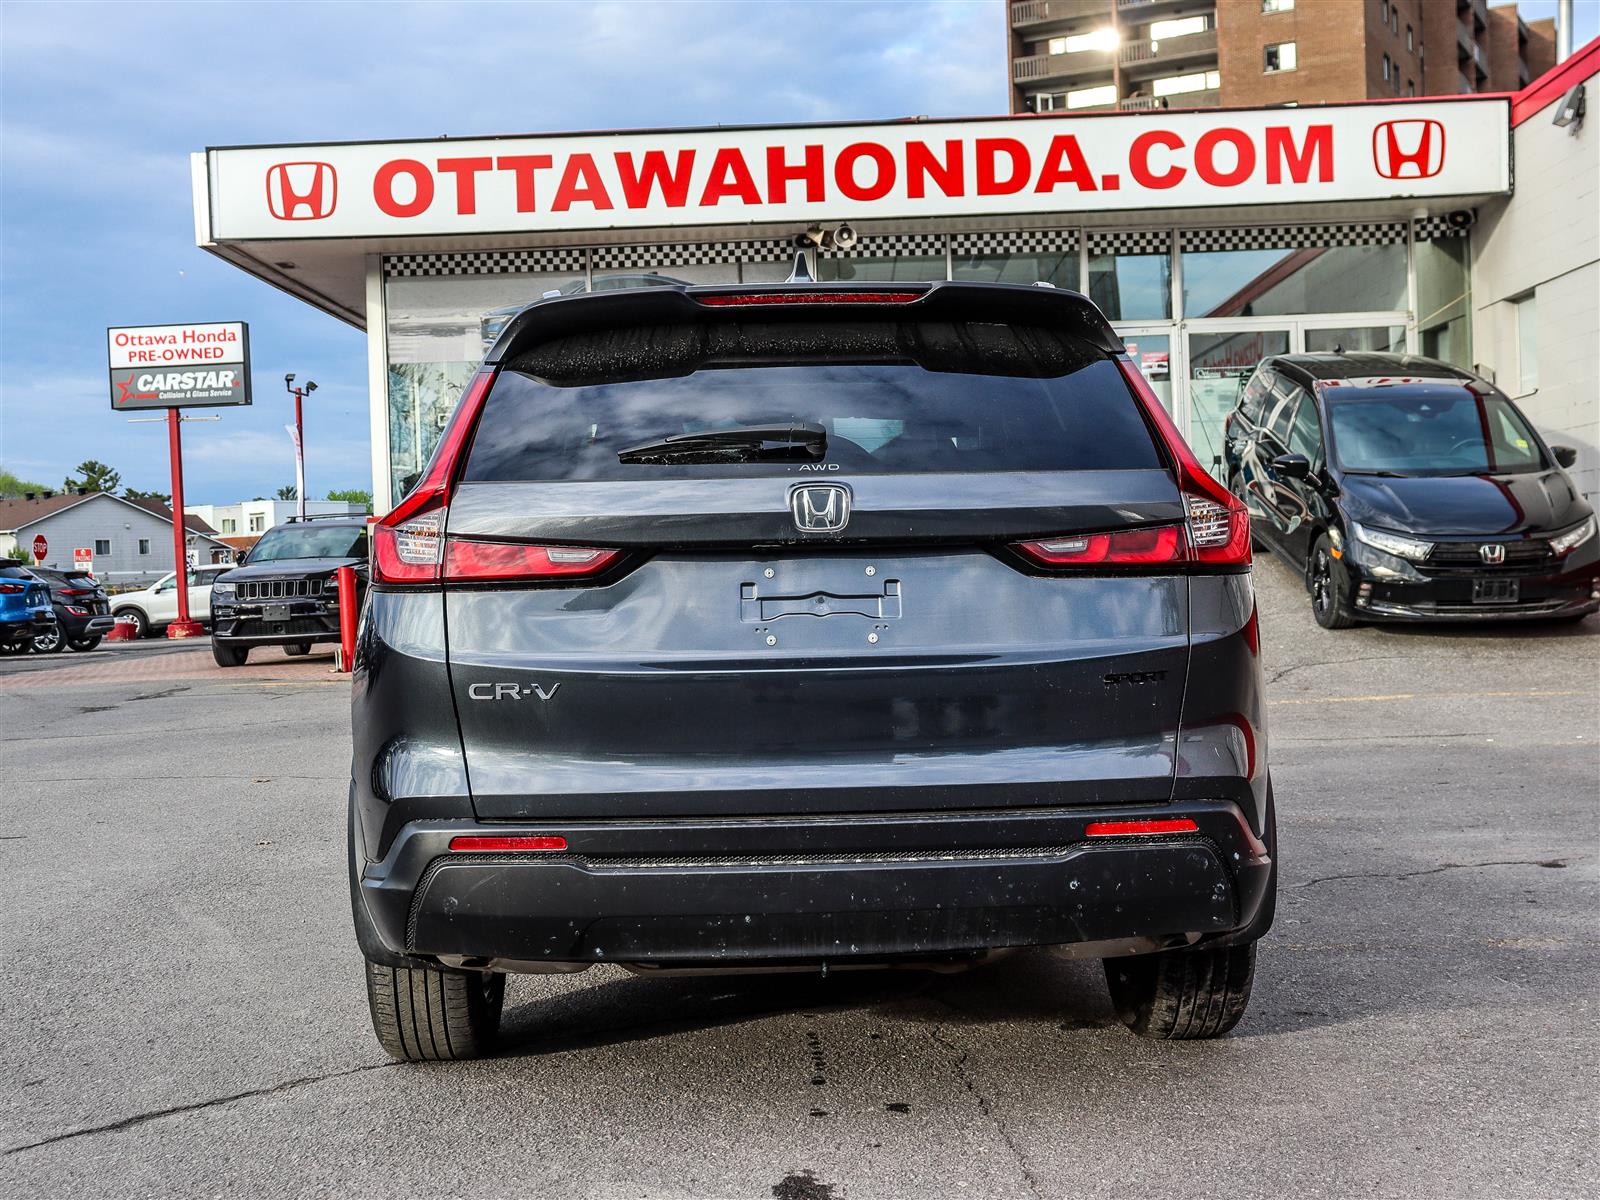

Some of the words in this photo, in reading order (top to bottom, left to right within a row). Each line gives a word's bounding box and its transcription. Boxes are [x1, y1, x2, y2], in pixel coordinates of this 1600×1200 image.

[374, 124, 1334, 217] OTTAWAHONDA.COM
[115, 332, 177, 347] Ottawa
[183, 328, 236, 343] Honda
[128, 347, 224, 362] PRE-OWNED
[137, 370, 235, 391] CARSTAR
[159, 391, 185, 400] Collision
[192, 390, 209, 398] Glass
[210, 389, 232, 397] Service
[799, 463, 840, 471] AWD
[34, 542, 47, 553] STOP
[1104, 670, 1168, 685] SPORT
[468, 682, 561, 700] CR-V
